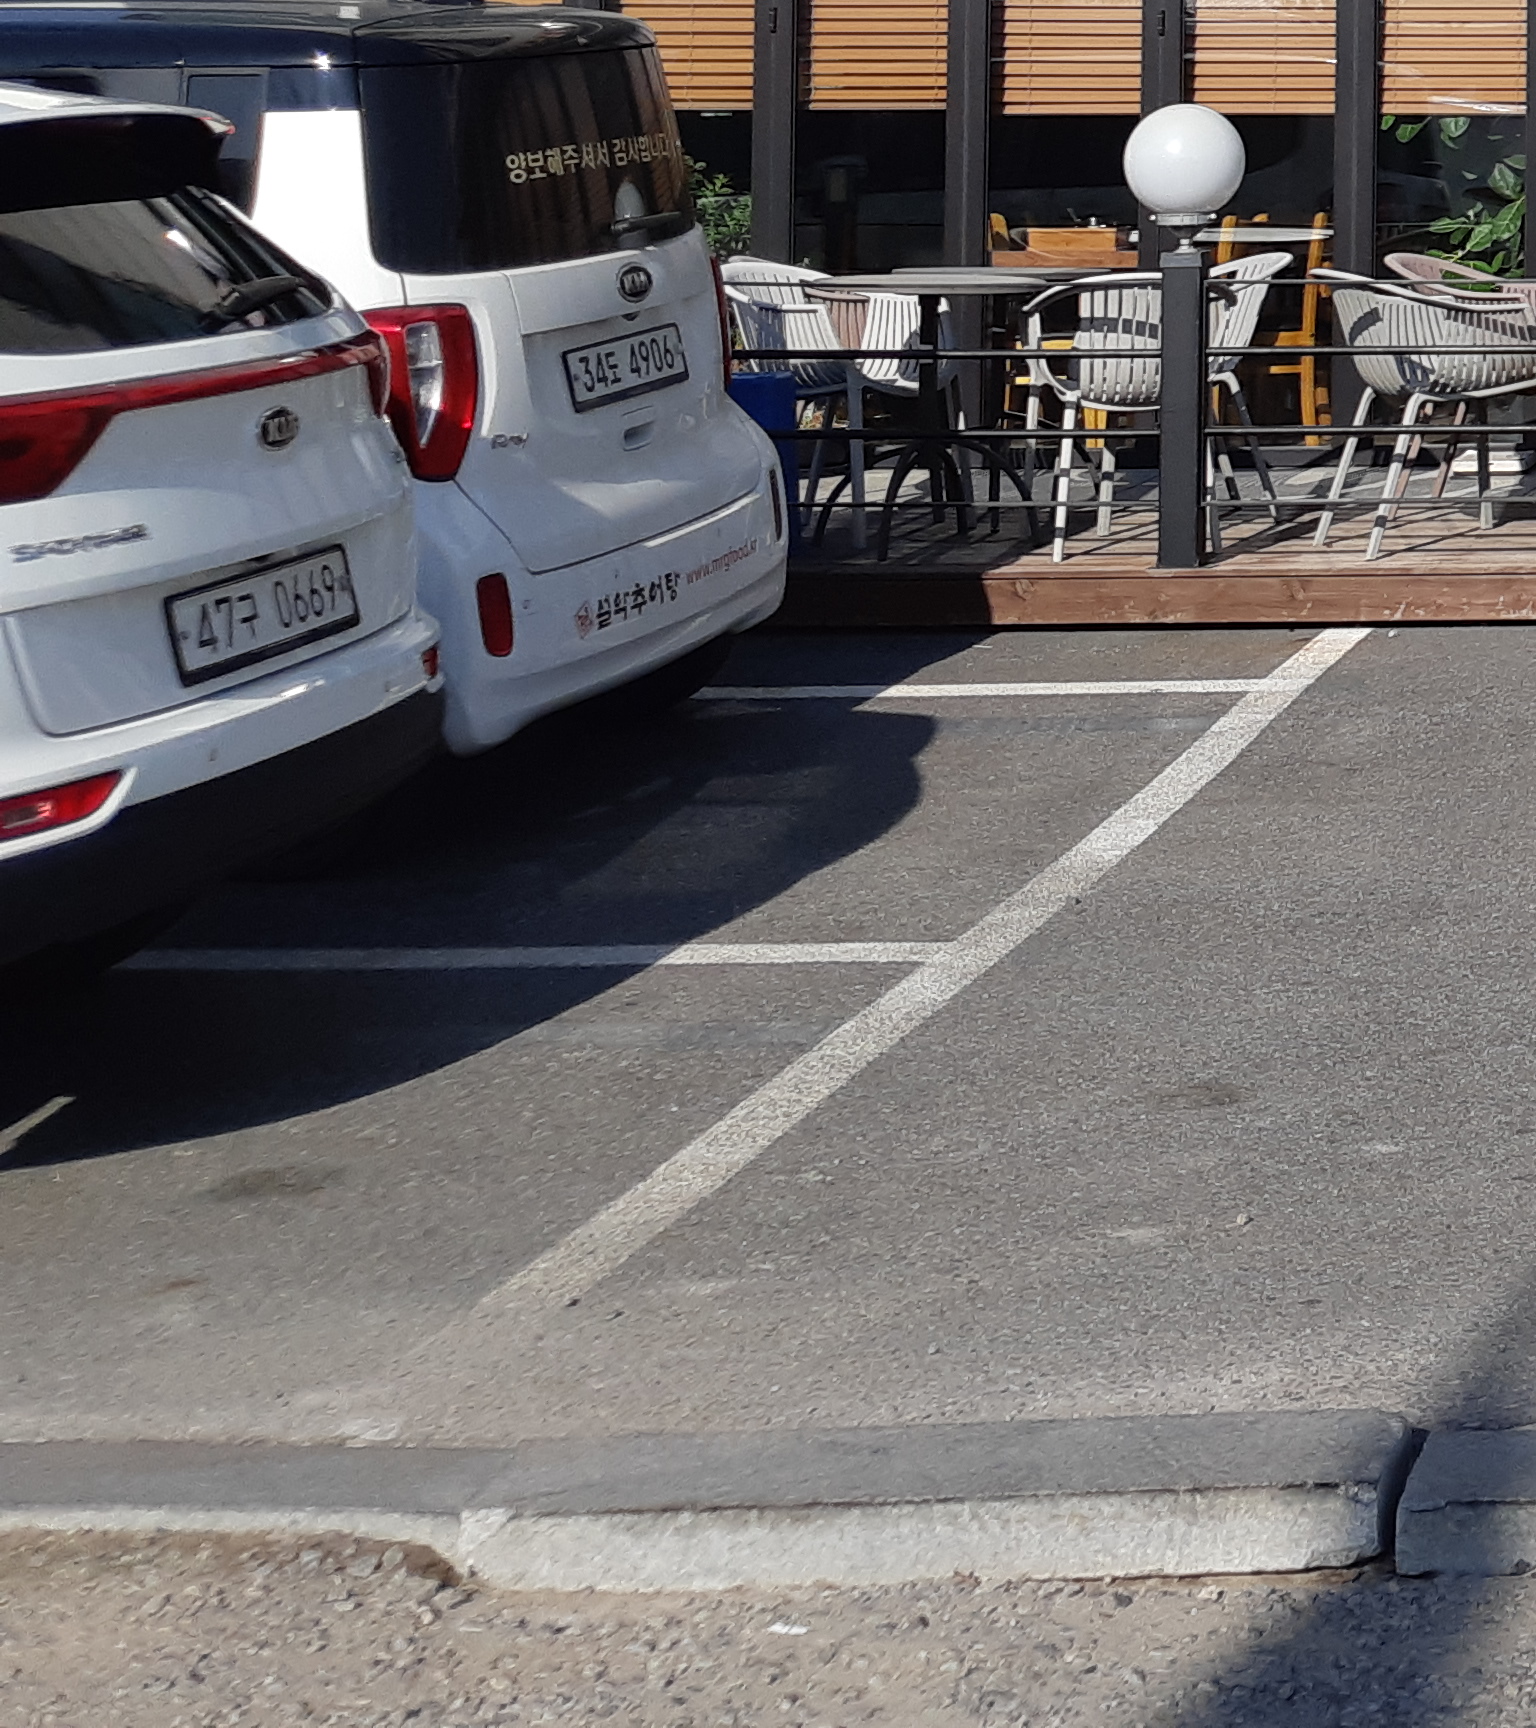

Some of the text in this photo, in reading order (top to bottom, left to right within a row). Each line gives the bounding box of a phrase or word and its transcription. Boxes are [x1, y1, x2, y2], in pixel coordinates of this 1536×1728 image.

[578, 334, 675, 393] 34도 4906
[198, 564, 338, 653] 47구 0669
[596, 571, 680, 631] 설악추어탕
